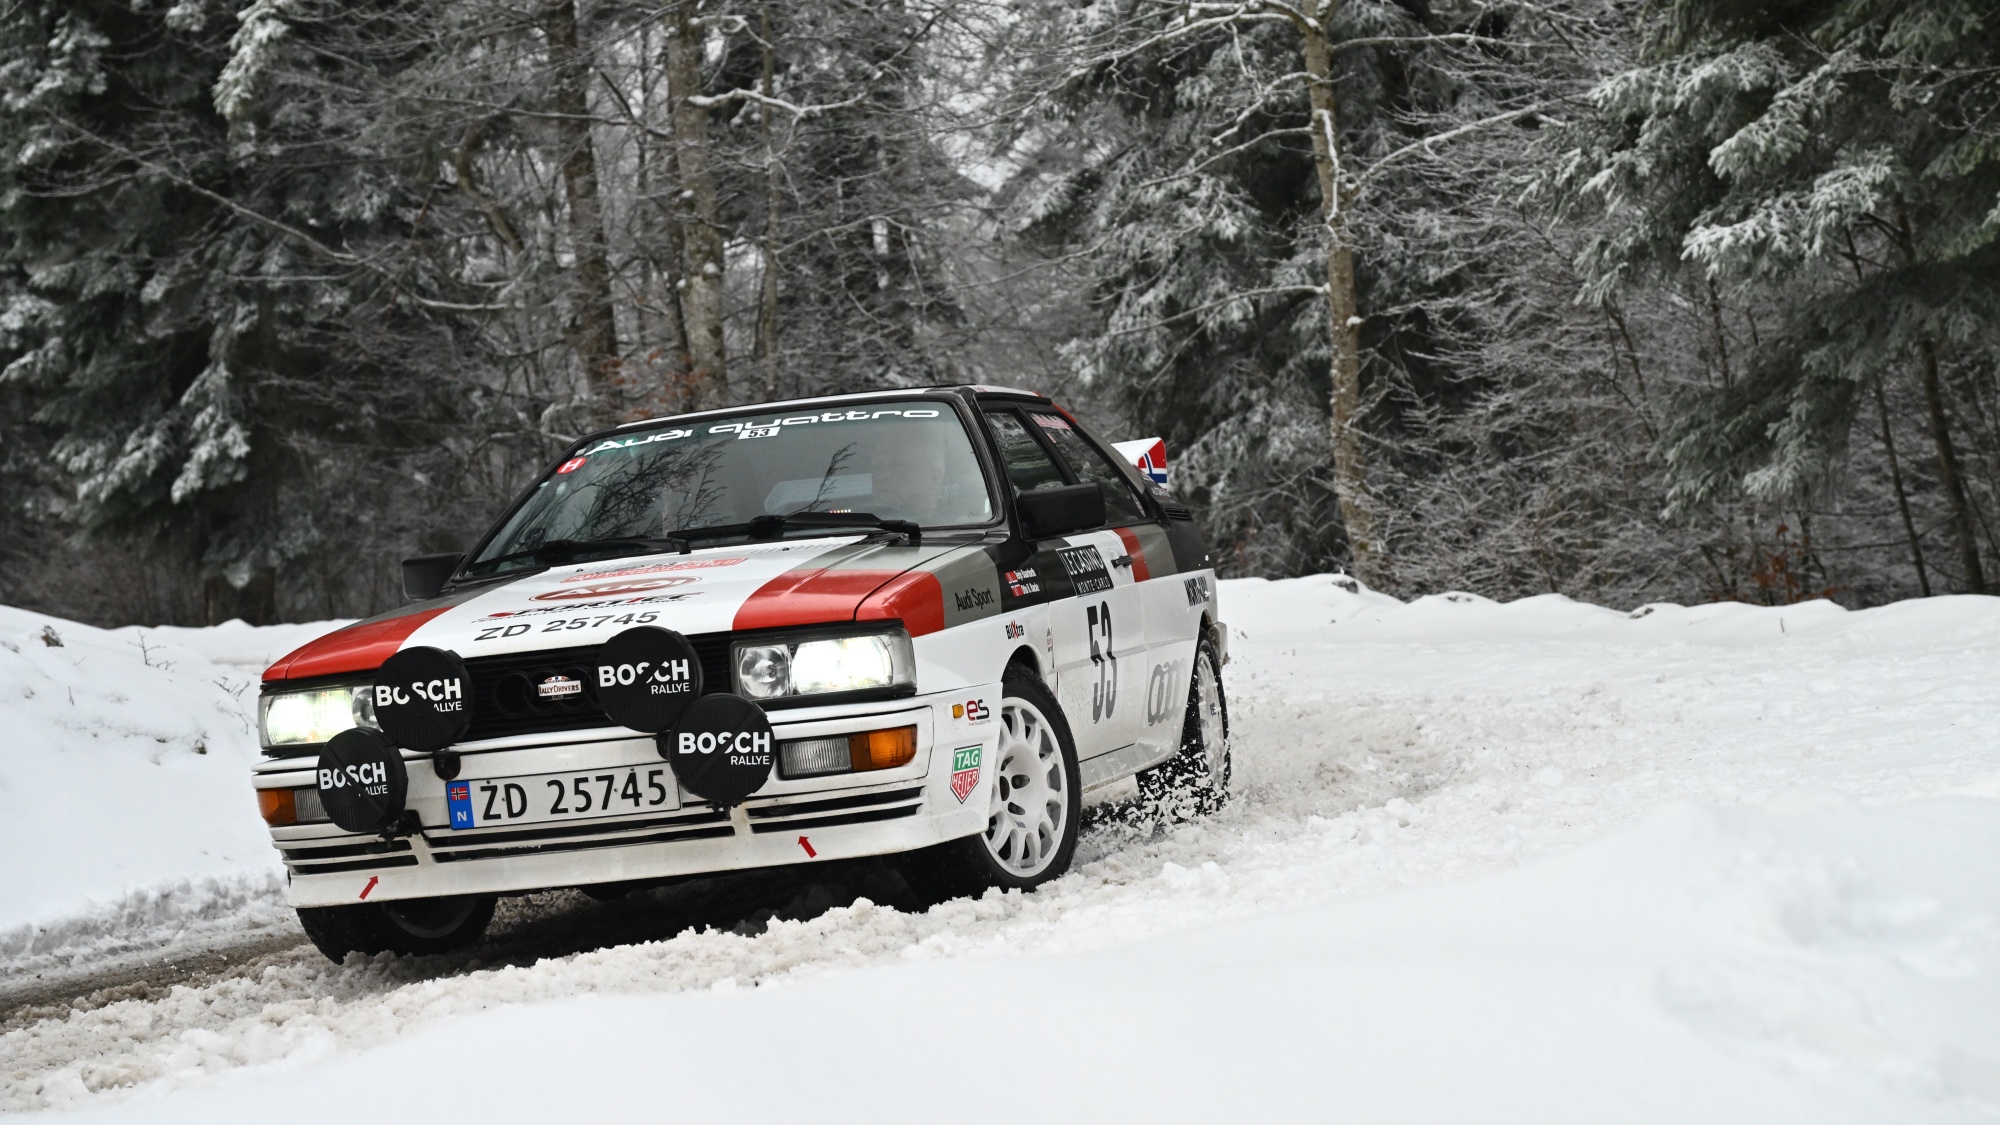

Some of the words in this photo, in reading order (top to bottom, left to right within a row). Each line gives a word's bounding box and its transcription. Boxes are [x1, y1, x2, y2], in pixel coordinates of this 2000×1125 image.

[585, 429, 694, 456] Audi
[709, 409, 939, 434] quattro
[749, 429, 770, 438] 53
[560, 458, 580, 473] H
[1061, 552, 1078, 576] LE
[1070, 547, 1104, 574] CASINO
[546, 578, 688, 599] Audi
[955, 589, 974, 612] Audi
[971, 587, 994, 610] Sport
[474, 623, 532, 641] ZD
[541, 611, 661, 633] 25745
[1087, 600, 1117, 724] 53
[375, 677, 462, 707] BOSCH
[650, 682, 690, 695] RALLYE
[433, 700, 463, 713] ALLYE
[679, 731, 770, 754] BOSCH
[730, 755, 770, 766] RALLYE
[956, 749, 979, 769] TAG
[318, 761, 387, 790] BOSCH
[952, 770, 978, 798] HEUER
[358, 784, 389, 798] ALLYE
[480, 783, 527, 820] ZD
[546, 769, 667, 815] 25745
[456, 810, 467, 822] N
